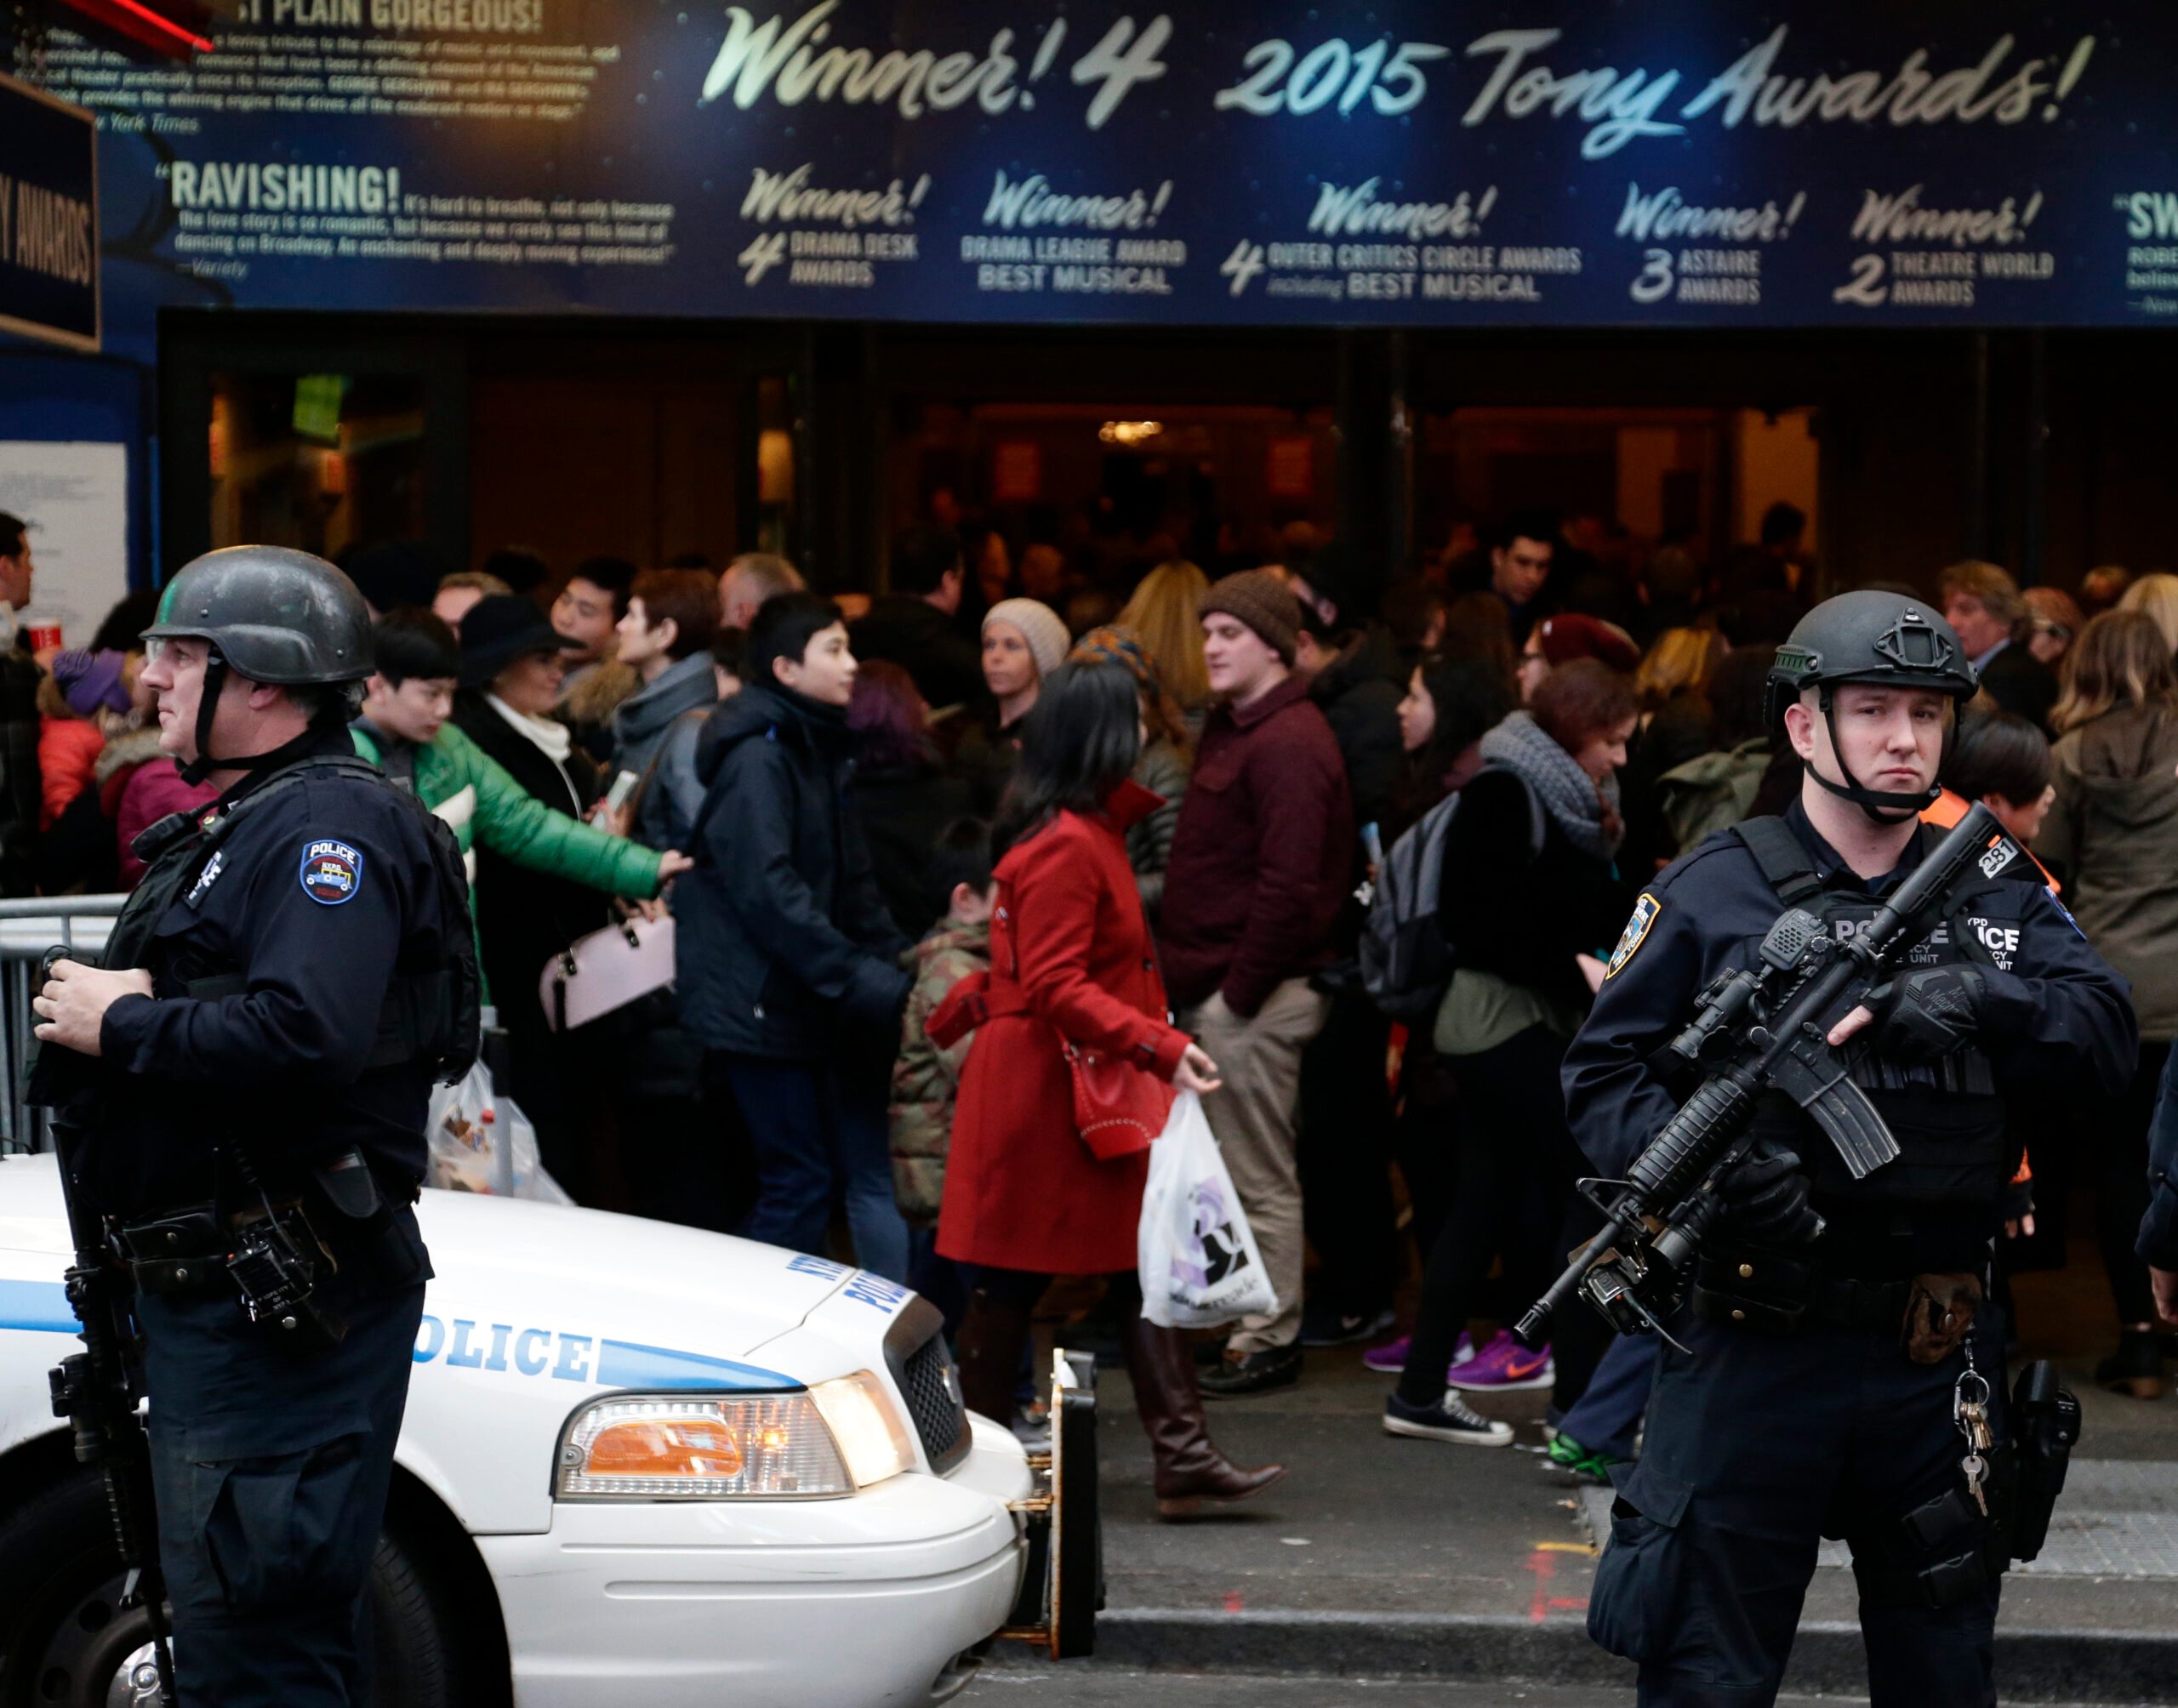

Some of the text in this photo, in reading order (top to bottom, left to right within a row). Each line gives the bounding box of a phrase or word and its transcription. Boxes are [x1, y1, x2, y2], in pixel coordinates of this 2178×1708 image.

[369, 0, 544, 34] GORGEOUS!
[702, 0, 2095, 160] Winner! 4 2015 Tony Awards!
[111, 112, 146, 133] York
[151, 111, 199, 134] Times
[430, 194, 465, 215] hard
[468, 196, 486, 216] to
[739, 161, 932, 229] Winner!
[982, 168, 1174, 231] Winner!
[1306, 175, 1500, 242] Winner!
[179, 210, 206, 230] the
[207, 212, 239, 230] love
[241, 213, 281, 235] story
[282, 213, 298, 230] is
[299, 216, 317, 232] so
[1615, 180, 1808, 242] Winner!
[1850, 182, 2044, 248] Winner!
[16, 179, 90, 286] AWARDS
[174, 231, 235, 257] dancing
[237, 236, 257, 251] on
[736, 231, 920, 288] 4 DRAMA DESK
[961, 236, 1188, 267] DRAMA LEAGUE AWARD
[788, 259, 876, 288] AWARDS
[978, 263, 1174, 294] BEST MUSICAL
[1219, 238, 1583, 298] 4 OUTER CRITICS CIRCLE AWARDS
[1628, 248, 1761, 305] 3 ASTAIRE
[1832, 251, 2055, 307] 2 THEATRE WORLD
[1346, 272, 1417, 299] BEST
[1420, 275, 1543, 301] MUSICAL
[1675, 277, 1761, 305] AWARDS
[1890, 279, 1976, 307] AWARDS
[310, 842, 356, 865] POLICE
[1966, 917, 1988, 926] YPD
[1628, 930, 1643, 952] YORK
[1910, 953, 1940, 965] UNIT
[412, 1314, 594, 1383] OLICE
